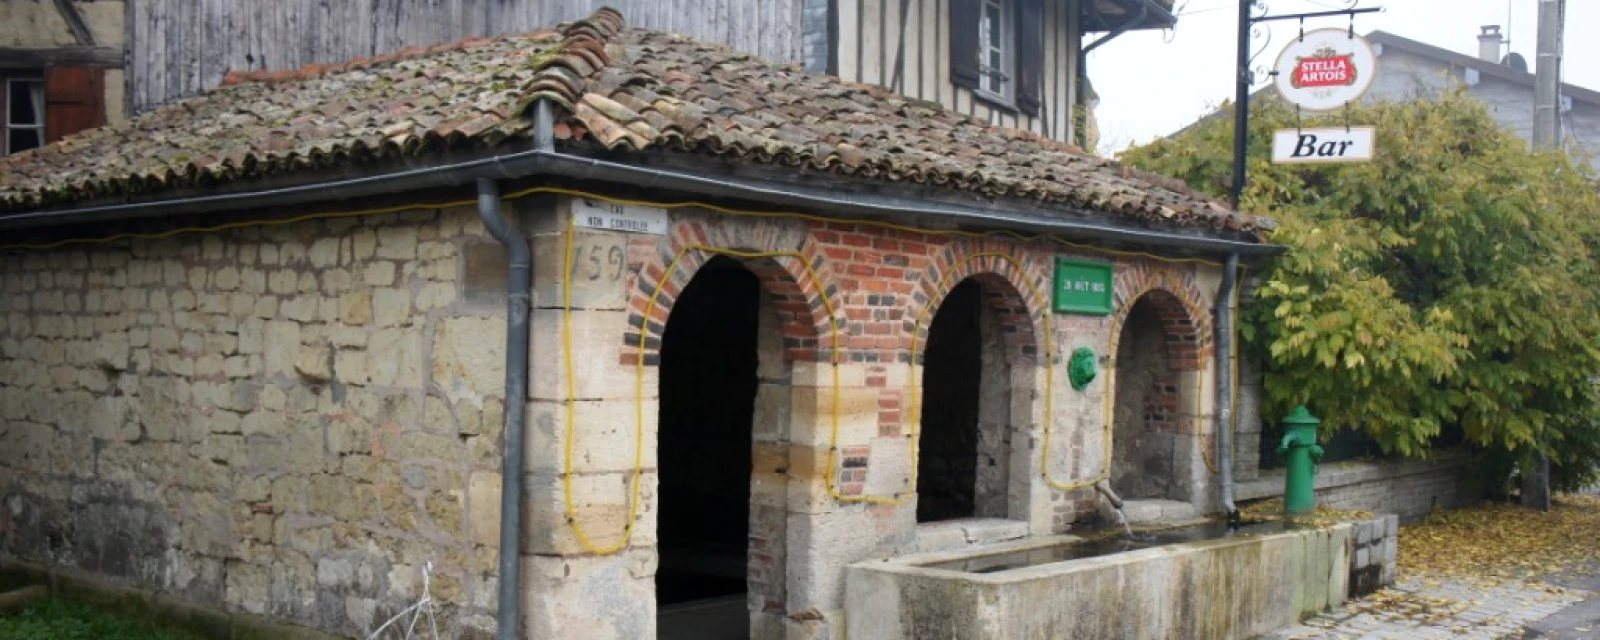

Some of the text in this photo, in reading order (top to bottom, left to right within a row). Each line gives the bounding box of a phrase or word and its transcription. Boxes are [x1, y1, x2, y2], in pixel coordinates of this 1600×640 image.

[1302, 60, 1346, 71] STELLA
[1301, 70, 1346, 82] ARTOIS
[1290, 133, 1353, 158] Bar
